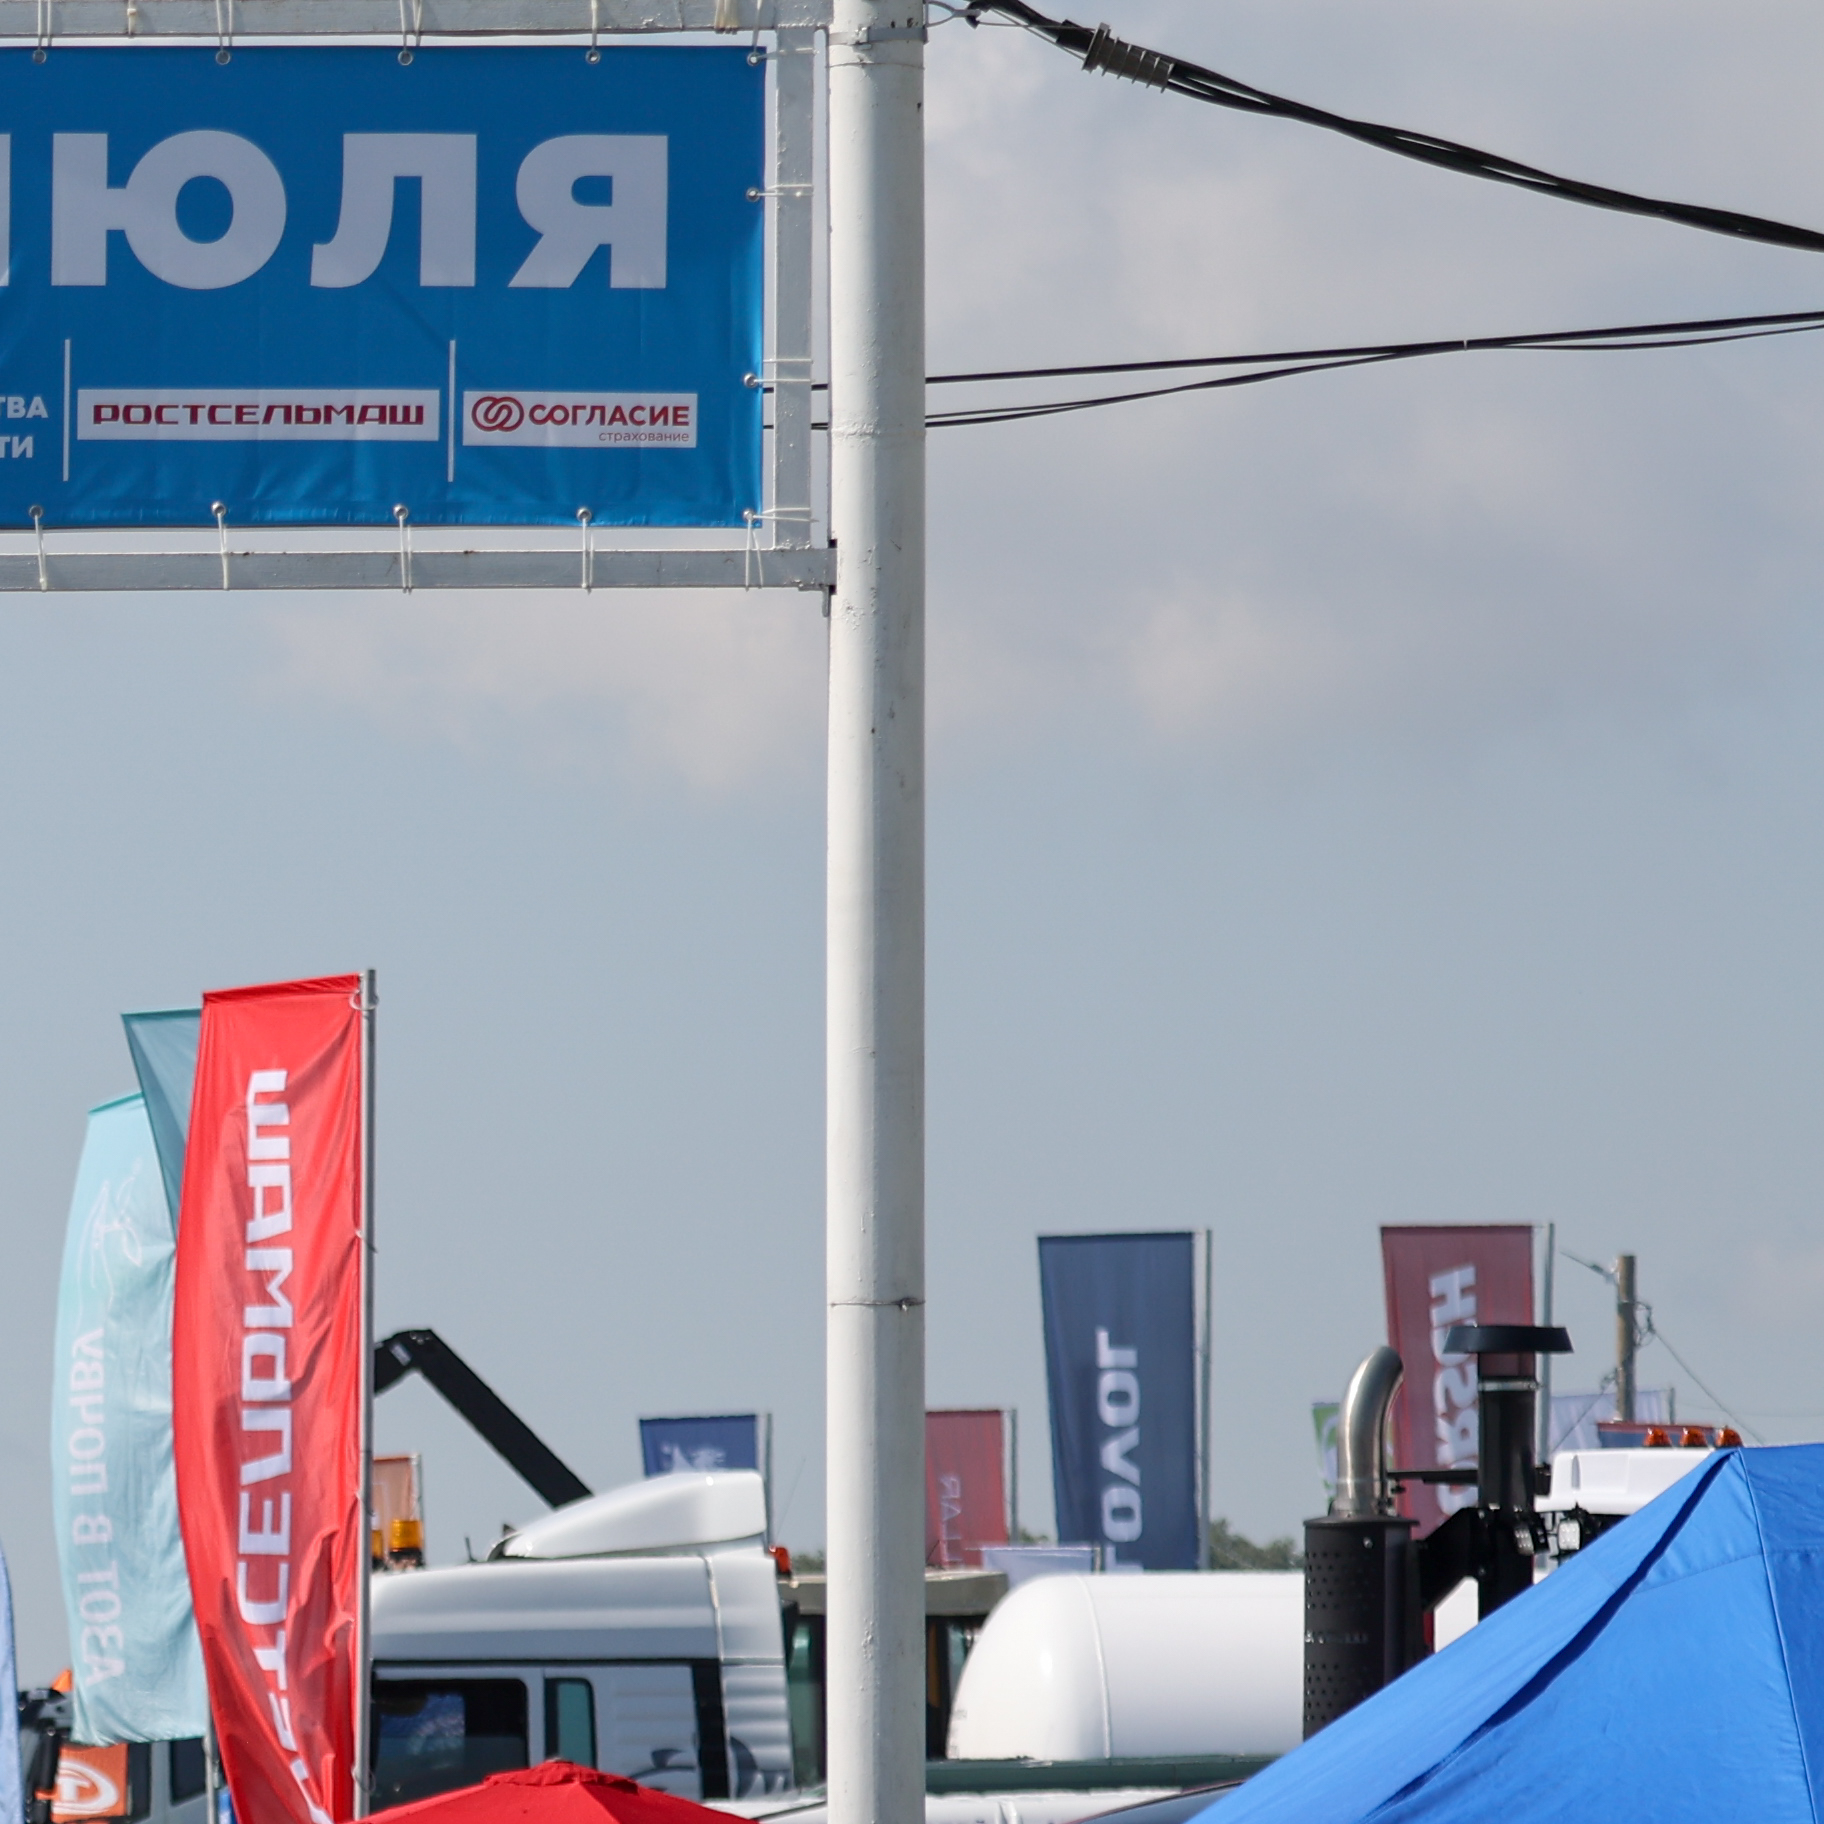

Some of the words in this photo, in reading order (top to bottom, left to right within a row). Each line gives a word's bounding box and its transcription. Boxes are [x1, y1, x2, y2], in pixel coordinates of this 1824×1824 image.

[93, 404, 425, 426] РОСТСЕЛЬМАШ
[529, 403, 690, 427] СОГЛАСИЕ
[598, 430, 690, 445] страхование
